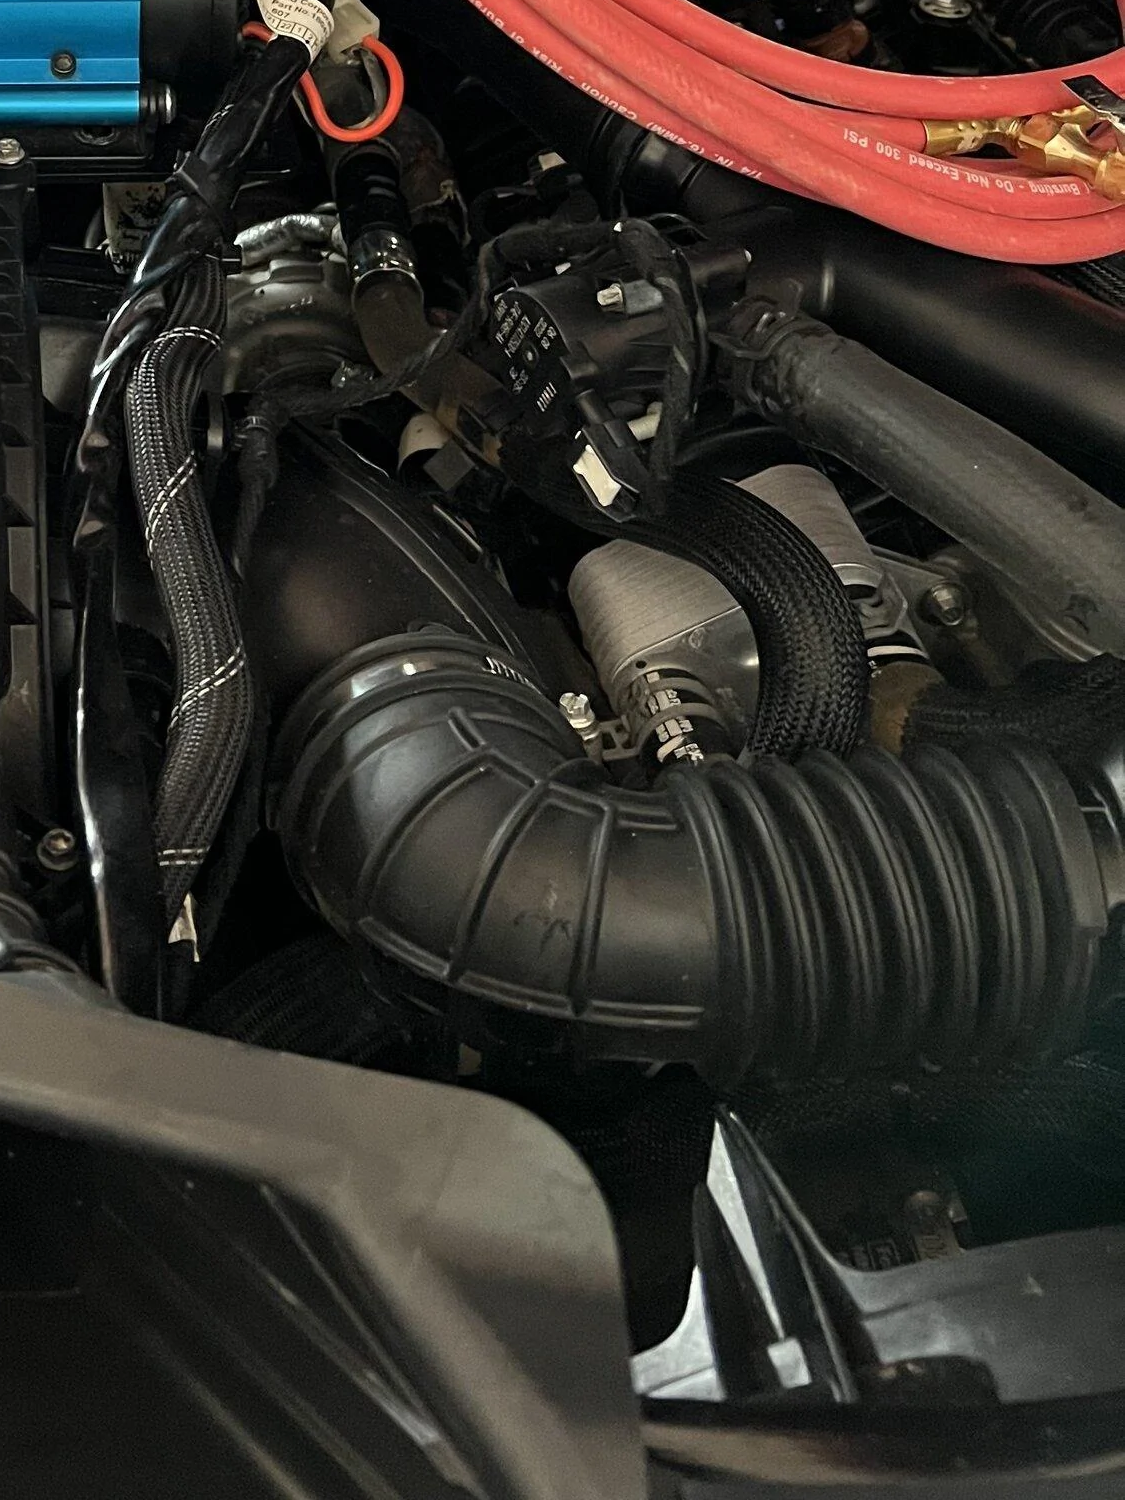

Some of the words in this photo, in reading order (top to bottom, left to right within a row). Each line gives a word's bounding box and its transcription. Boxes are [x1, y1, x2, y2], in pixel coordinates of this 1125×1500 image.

[271, 0, 293, 11] Part
[271, 8, 291, 19] 607
[580, 81, 638, 121] Caution
[645, 121, 706, 156] (6.4MM)
[842, 127, 869, 149] PSI
[875, 140, 902, 162] 300
[714, 153, 735, 168] IN.
[908, 155, 960, 181] Exceed
[965, 171, 990, 189] Not
[995, 177, 1016, 194] Do
[1029, 181, 1082, 196] Bursting
